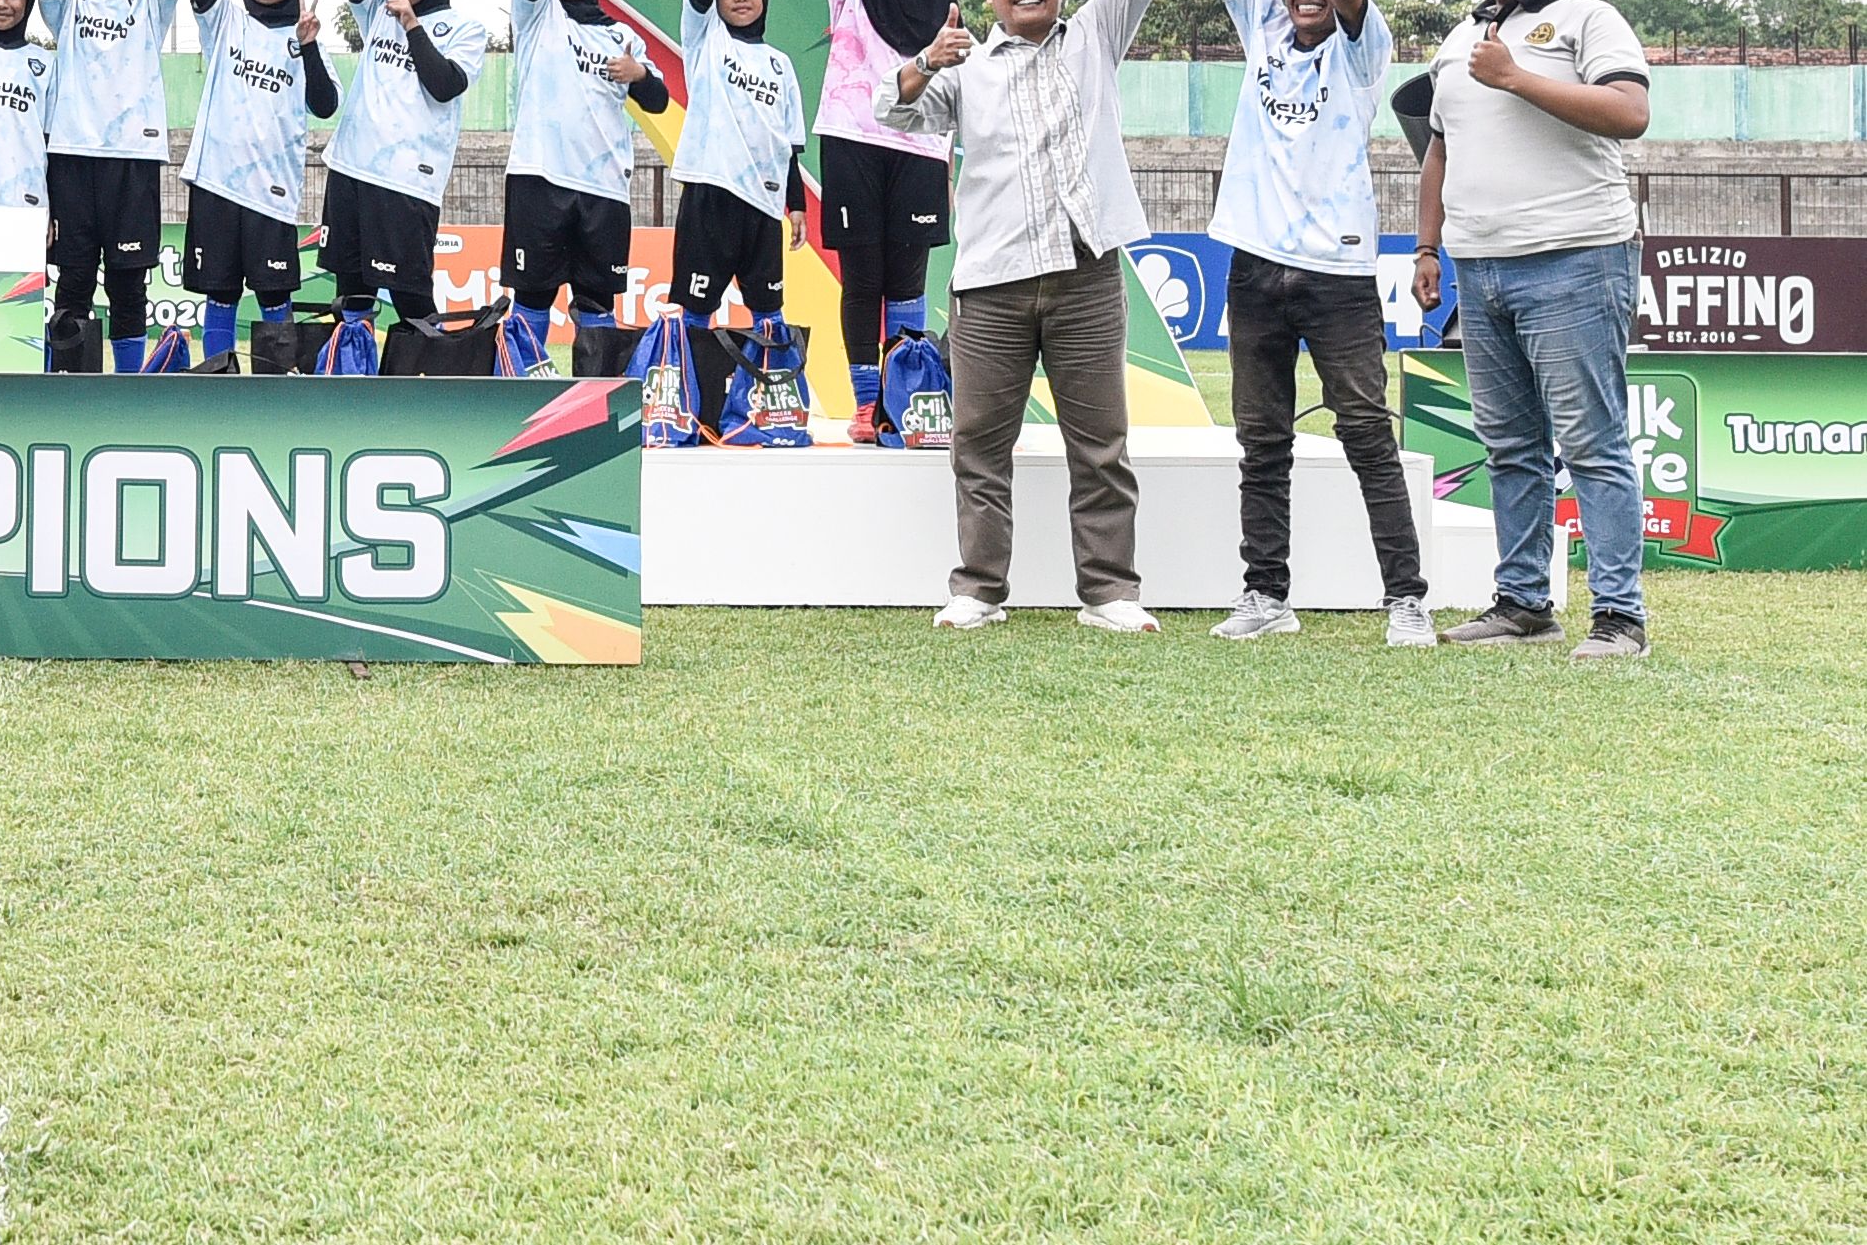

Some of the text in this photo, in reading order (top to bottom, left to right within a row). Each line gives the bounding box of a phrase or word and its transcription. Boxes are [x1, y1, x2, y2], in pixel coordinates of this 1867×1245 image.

[371, 36, 412, 56] VANGU
[229, 45, 294, 87] VAGUARD
[374, 50, 416, 73] UNITE
[1266, 55, 1286, 72] OCK
[840, 206, 849, 229] 1
[319, 225, 330, 248] 8
[515, 248, 525, 271] 9
[1656, 245, 1747, 269] DELIZIO
[689, 272, 710, 299] 12
[1637, 275, 1814, 345] AFFINO
[766, 391, 800, 411] Life
[1627, 383, 1683, 440] lk
[1630, 438, 1688, 493] fe
